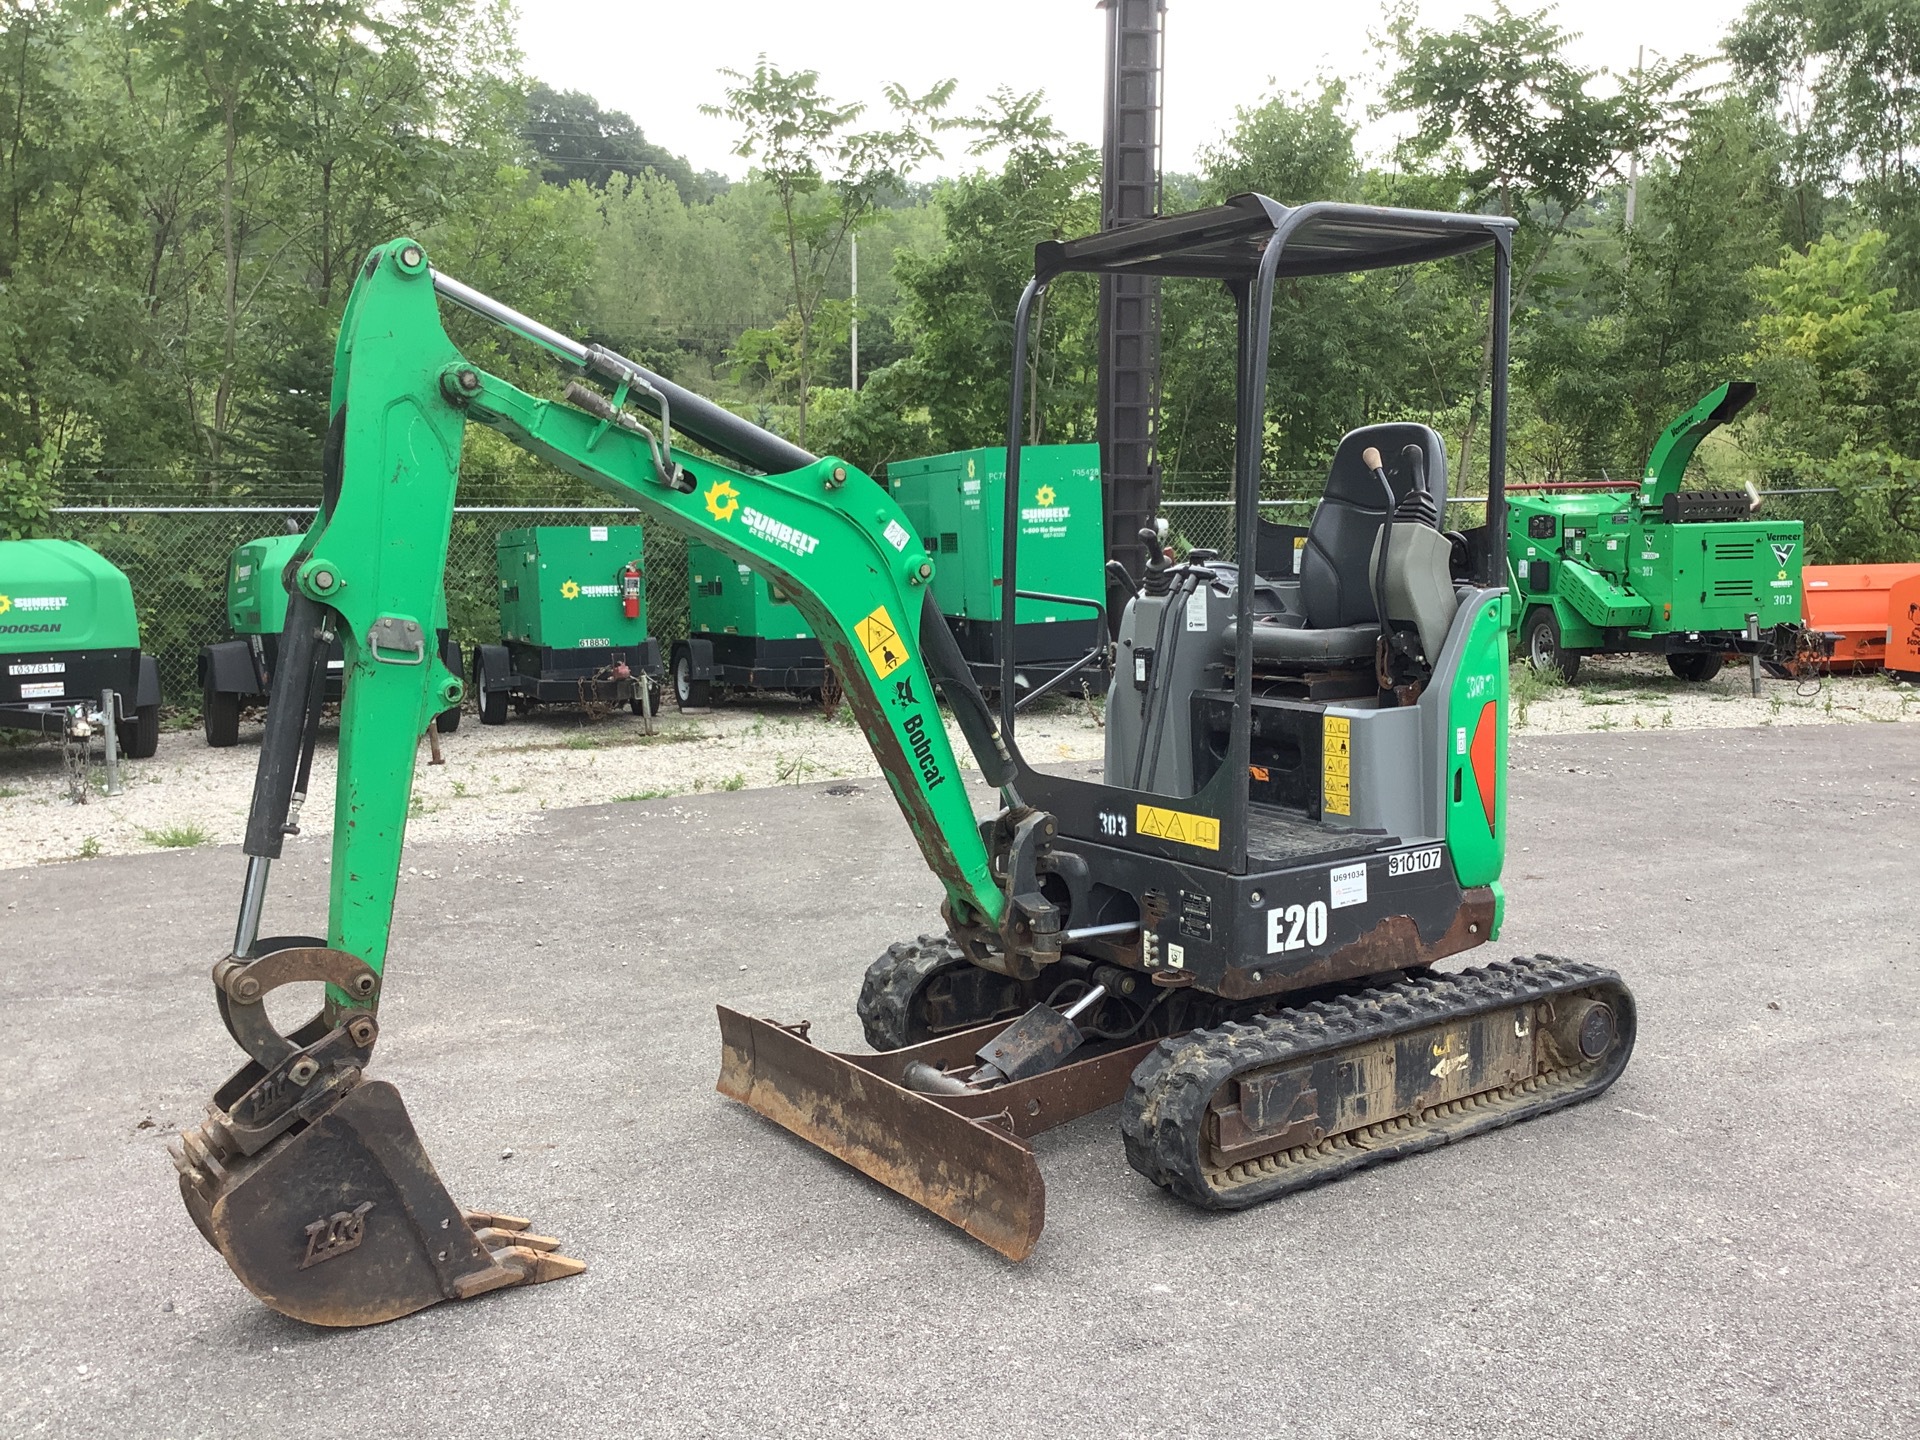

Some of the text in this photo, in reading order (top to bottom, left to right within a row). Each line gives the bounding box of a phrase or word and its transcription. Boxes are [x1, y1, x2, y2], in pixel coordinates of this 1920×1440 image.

[1021, 507, 1070, 520] SUNBELT
[741, 507, 819, 555] SUNBELT
[1766, 533, 1801, 541] Vermeer
[748, 526, 805, 557] RENTALS
[14, 596, 67, 608] SUNBELT
[1773, 594, 1793, 606] 303
[580, 639, 609, 647] 618830
[902, 713, 945, 791] Bobcat
[1099, 811, 1128, 838] 303
[1389, 850, 1441, 875] 910107
[1332, 869, 1365, 883] U691034
[1267, 900, 1328, 954] E20
